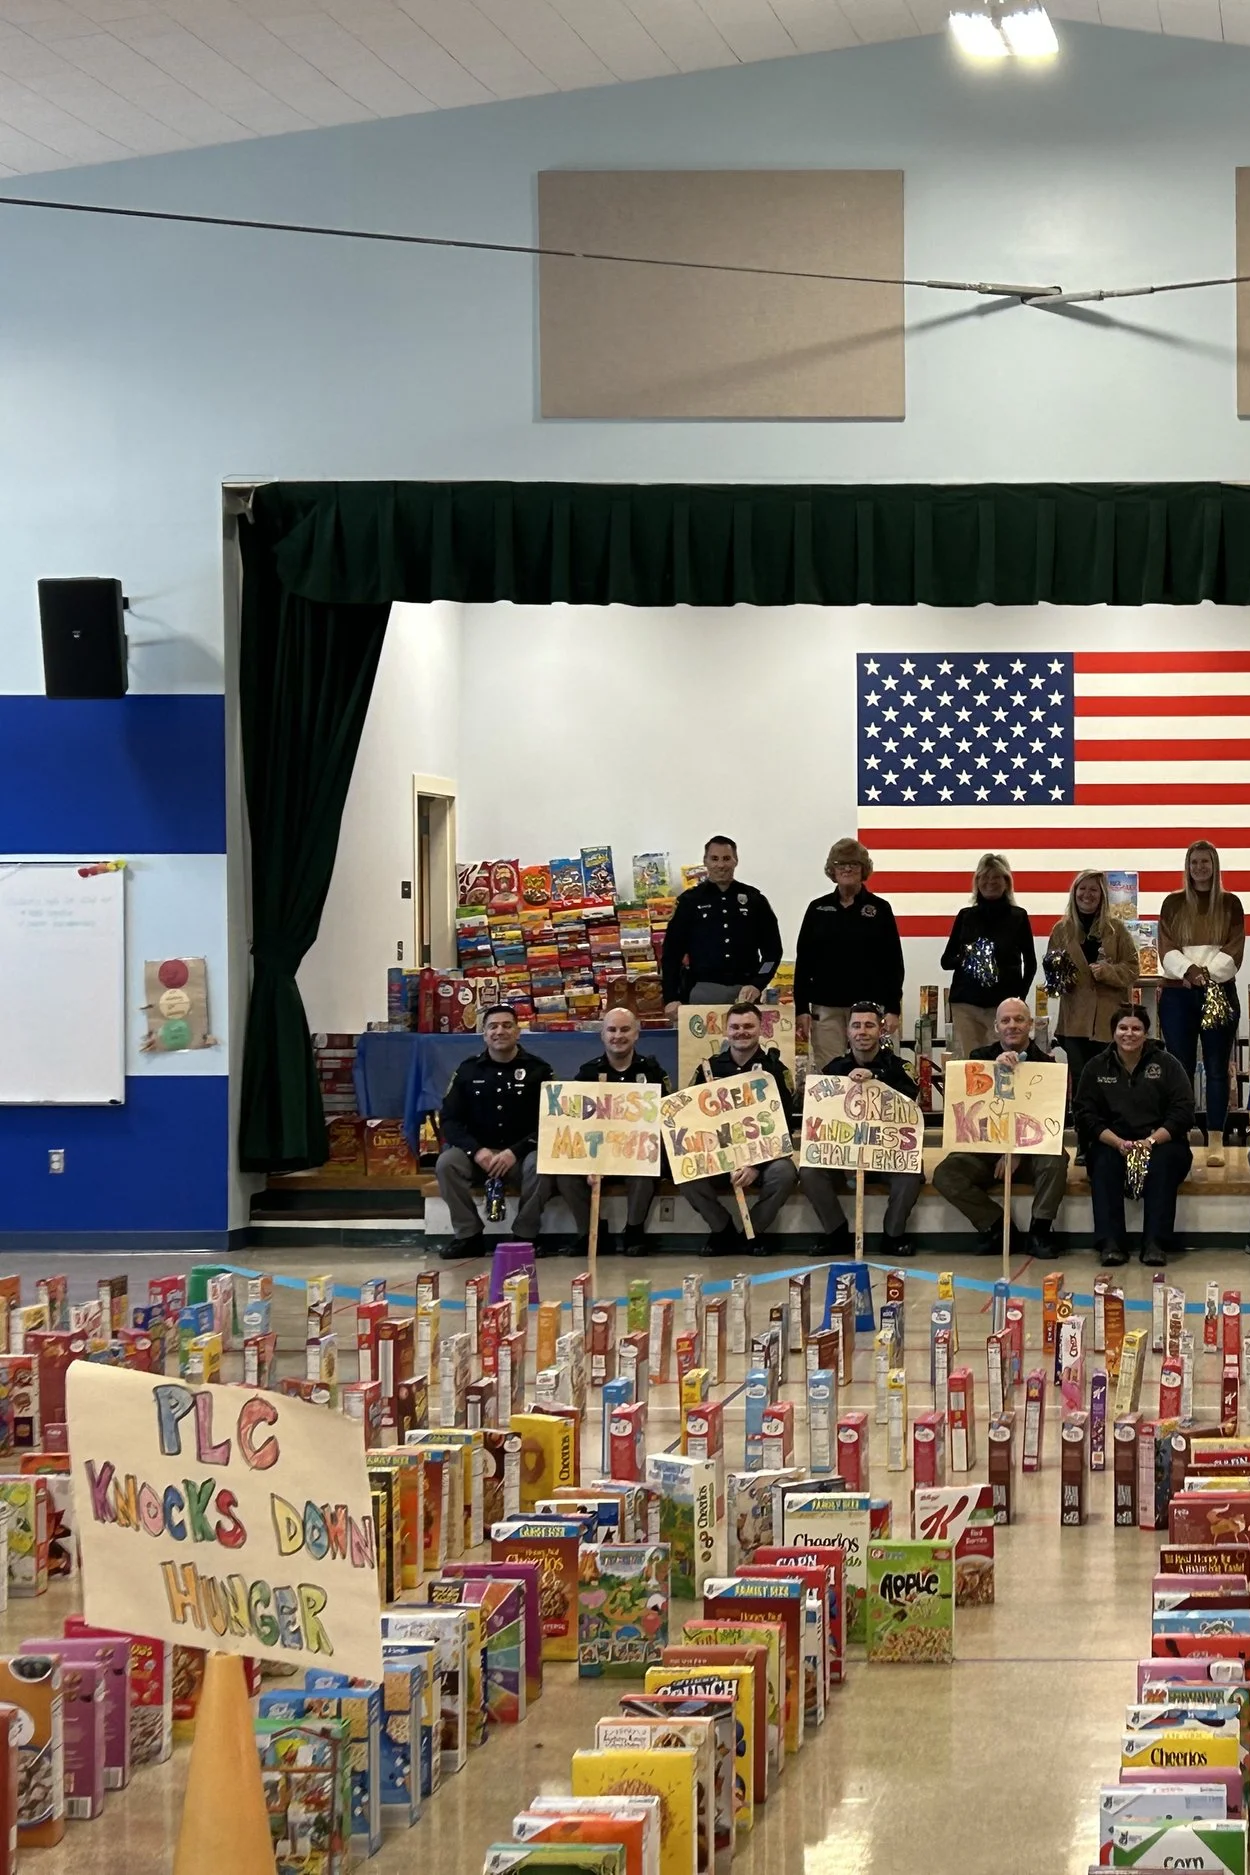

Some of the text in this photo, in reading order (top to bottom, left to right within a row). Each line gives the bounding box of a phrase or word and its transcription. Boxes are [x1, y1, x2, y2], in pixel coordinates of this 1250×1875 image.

[660, 1079, 768, 1122] THE GREAT
[807, 1077, 919, 1125] THE GREAT
[964, 1062, 1016, 1100] BE
[545, 1084, 658, 1122] KINDNESS
[551, 1125, 658, 1163] MATTERS
[669, 1111, 776, 1157] KINDNESS
[805, 1117, 917, 1150] KINDNESS
[952, 1100, 1046, 1148] KIND
[680, 1133, 793, 1179] CHALLENGE
[806, 1143, 920, 1171] CHALLENGE
[153, 1383, 281, 1471] PLC
[85, 1459, 375, 1569] KNOCKS DOWN
[793, 1533, 860, 1553] Cheerios
[880, 1573, 940, 1600] APPLE
[160, 1560, 333, 1656] HUNGER
[1150, 1747, 1207, 1768] Cheerios
